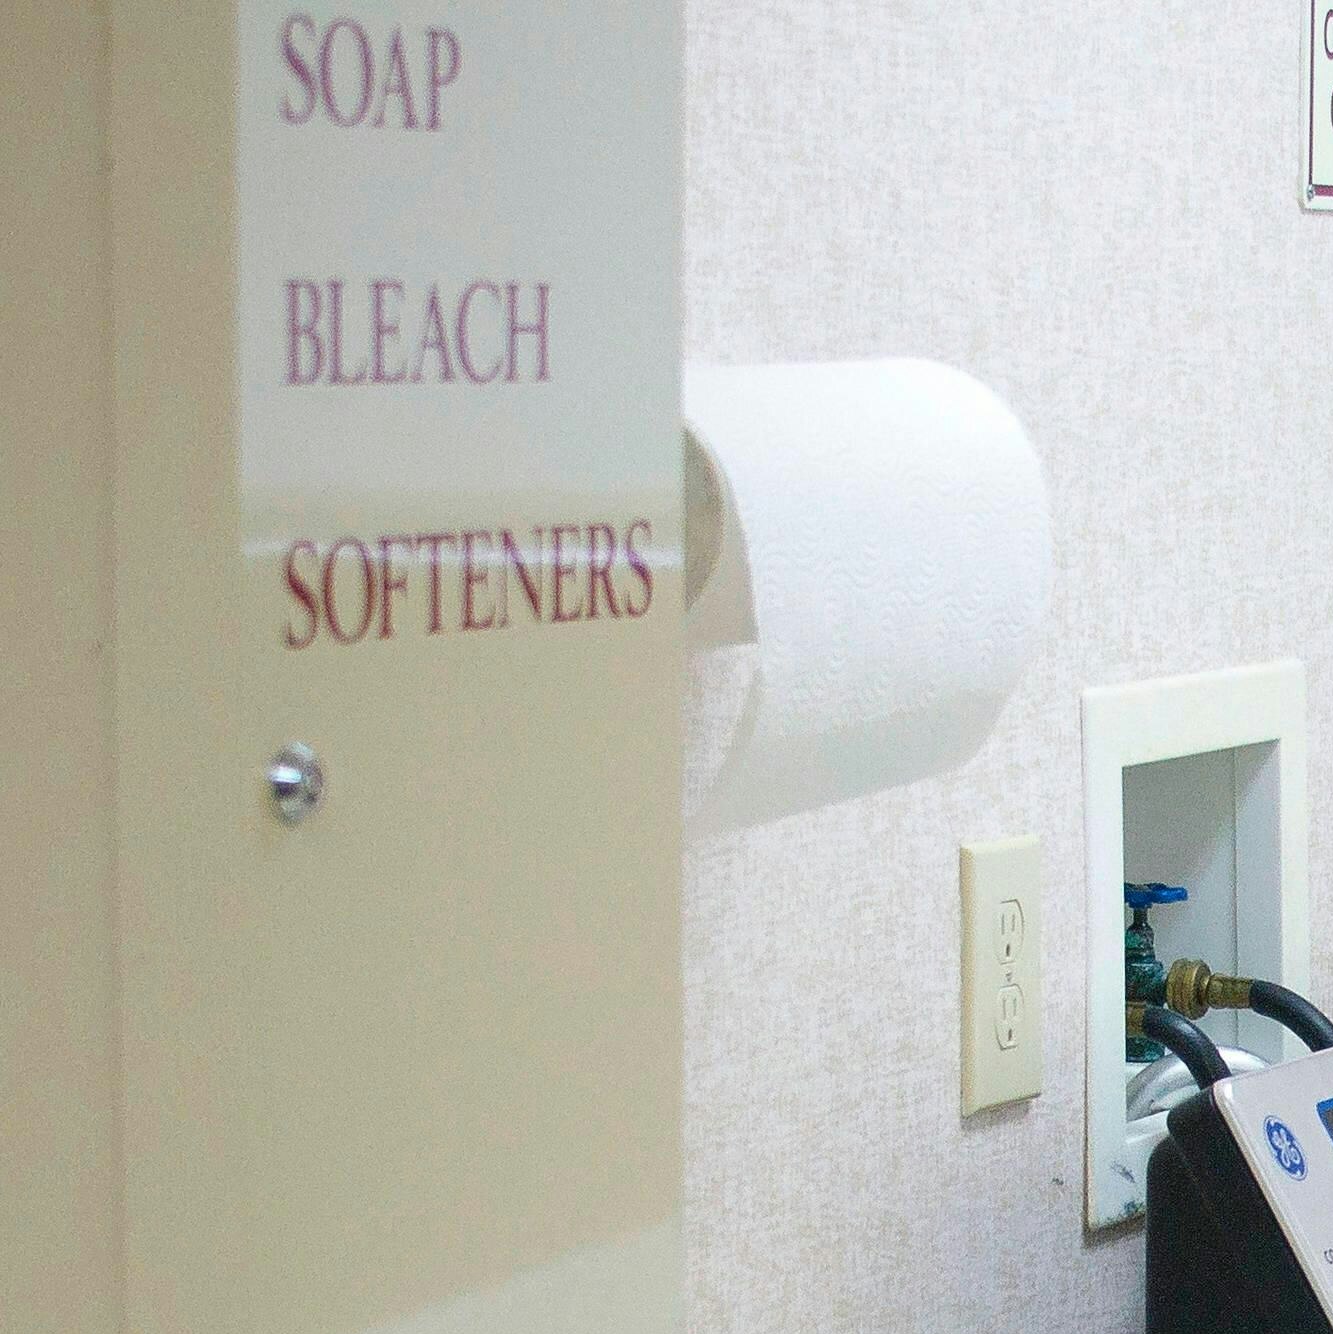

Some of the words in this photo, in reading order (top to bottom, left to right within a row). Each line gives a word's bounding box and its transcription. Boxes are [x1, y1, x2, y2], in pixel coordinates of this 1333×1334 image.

[280, 13, 462, 131] SOAP
[282, 279, 552, 386] BLEACH
[282, 516, 655, 651] SOFTENERS
